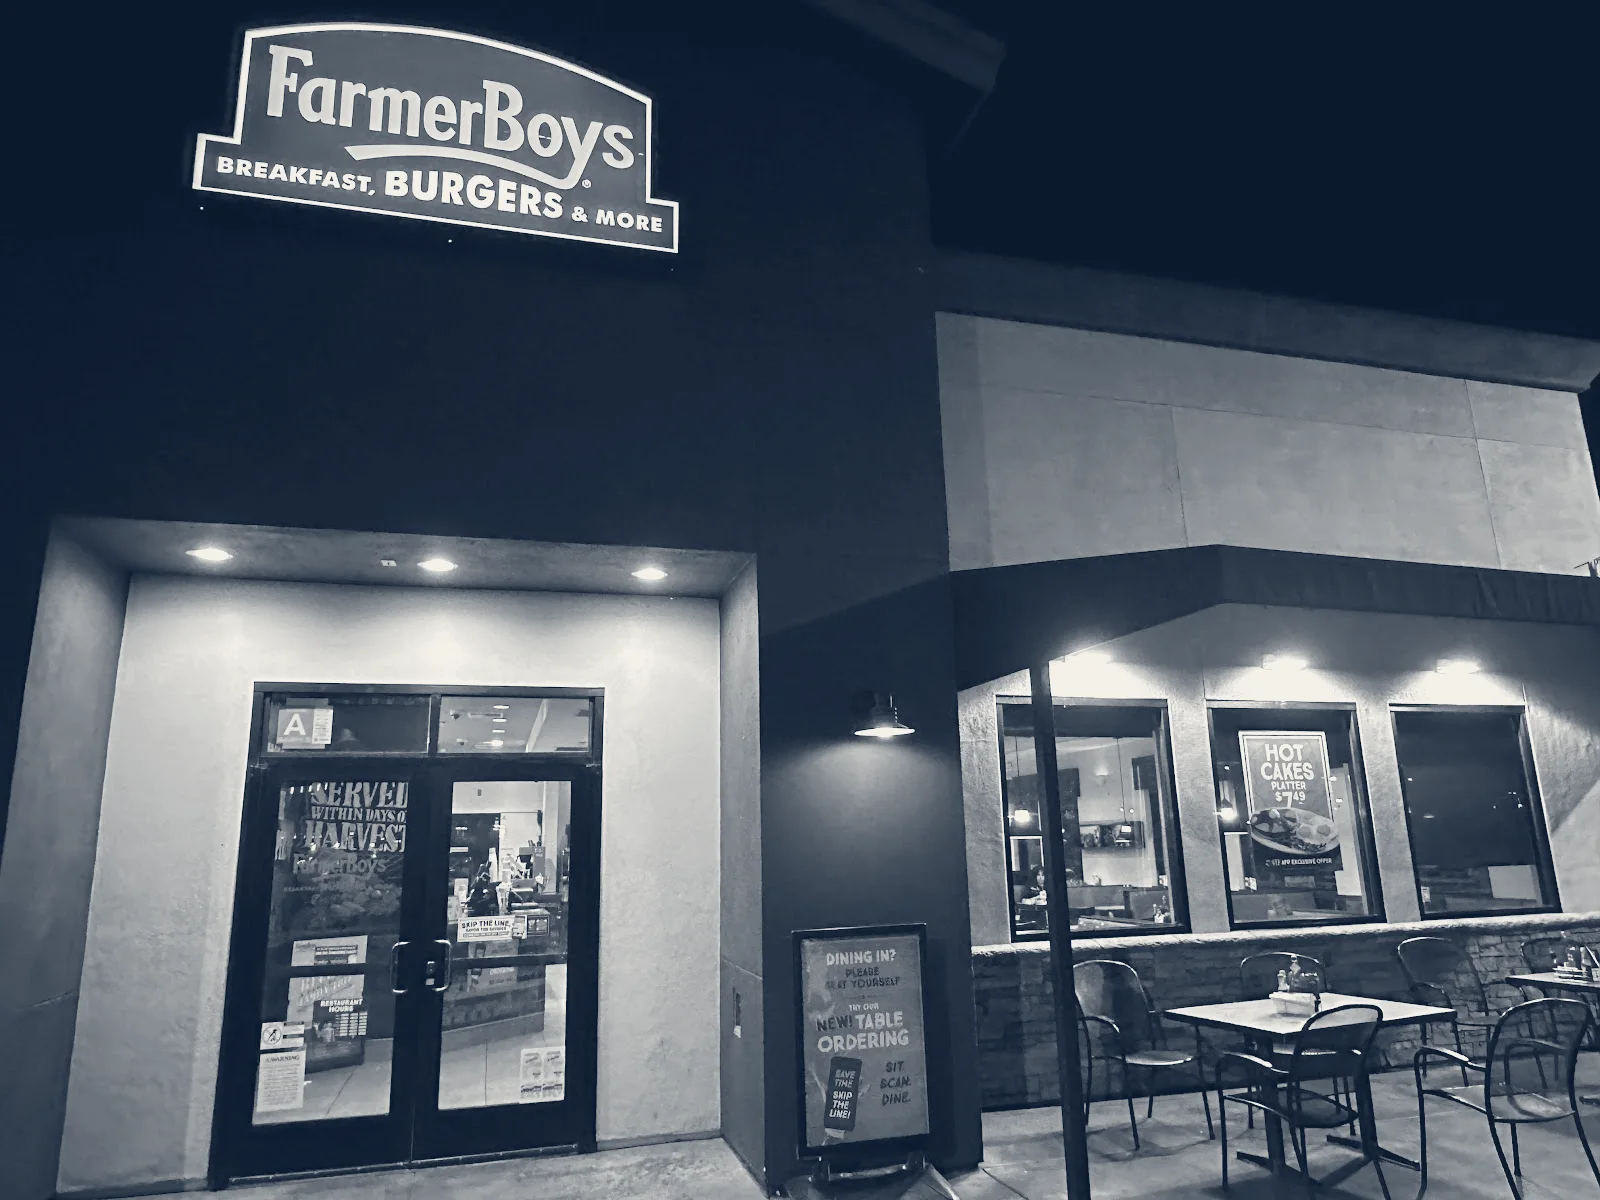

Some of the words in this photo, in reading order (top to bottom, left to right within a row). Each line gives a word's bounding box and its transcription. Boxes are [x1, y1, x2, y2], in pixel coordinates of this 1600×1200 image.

[216, 156, 376, 197] BREAKFAST,
[384, 170, 564, 219] BURGERS
[571, 205, 589, 223] &
[595, 210, 664, 233] MORE
[283, 713, 307, 736] A
[1264, 743, 1304, 762] HOT
[1260, 762, 1315, 781] CAKES
[1271, 781, 1307, 791] PLATTER
[311, 806, 363, 821] WITHIN
[366, 808, 396, 822] DAYS
[397, 810, 408, 824] O
[302, 820, 407, 852] HARVEST
[461, 921, 478, 929] SKIP
[826, 951, 872, 966] DINING
[876, 949, 896, 962] IN?
[845, 966, 880, 977] PLEASE
[851, 976, 900, 988] YOURSELF
[816, 1015, 852, 1031] NEW!
[854, 1011, 903, 1029] TABLE
[817, 1028, 909, 1053] ORDERING
[835, 1070, 856, 1079] SAVE
[834, 1079, 854, 1088] TIME
[832, 1091, 853, 1100] SKIP
[832, 1100, 850, 1109] THE
[829, 1109, 851, 1119] LINE!
